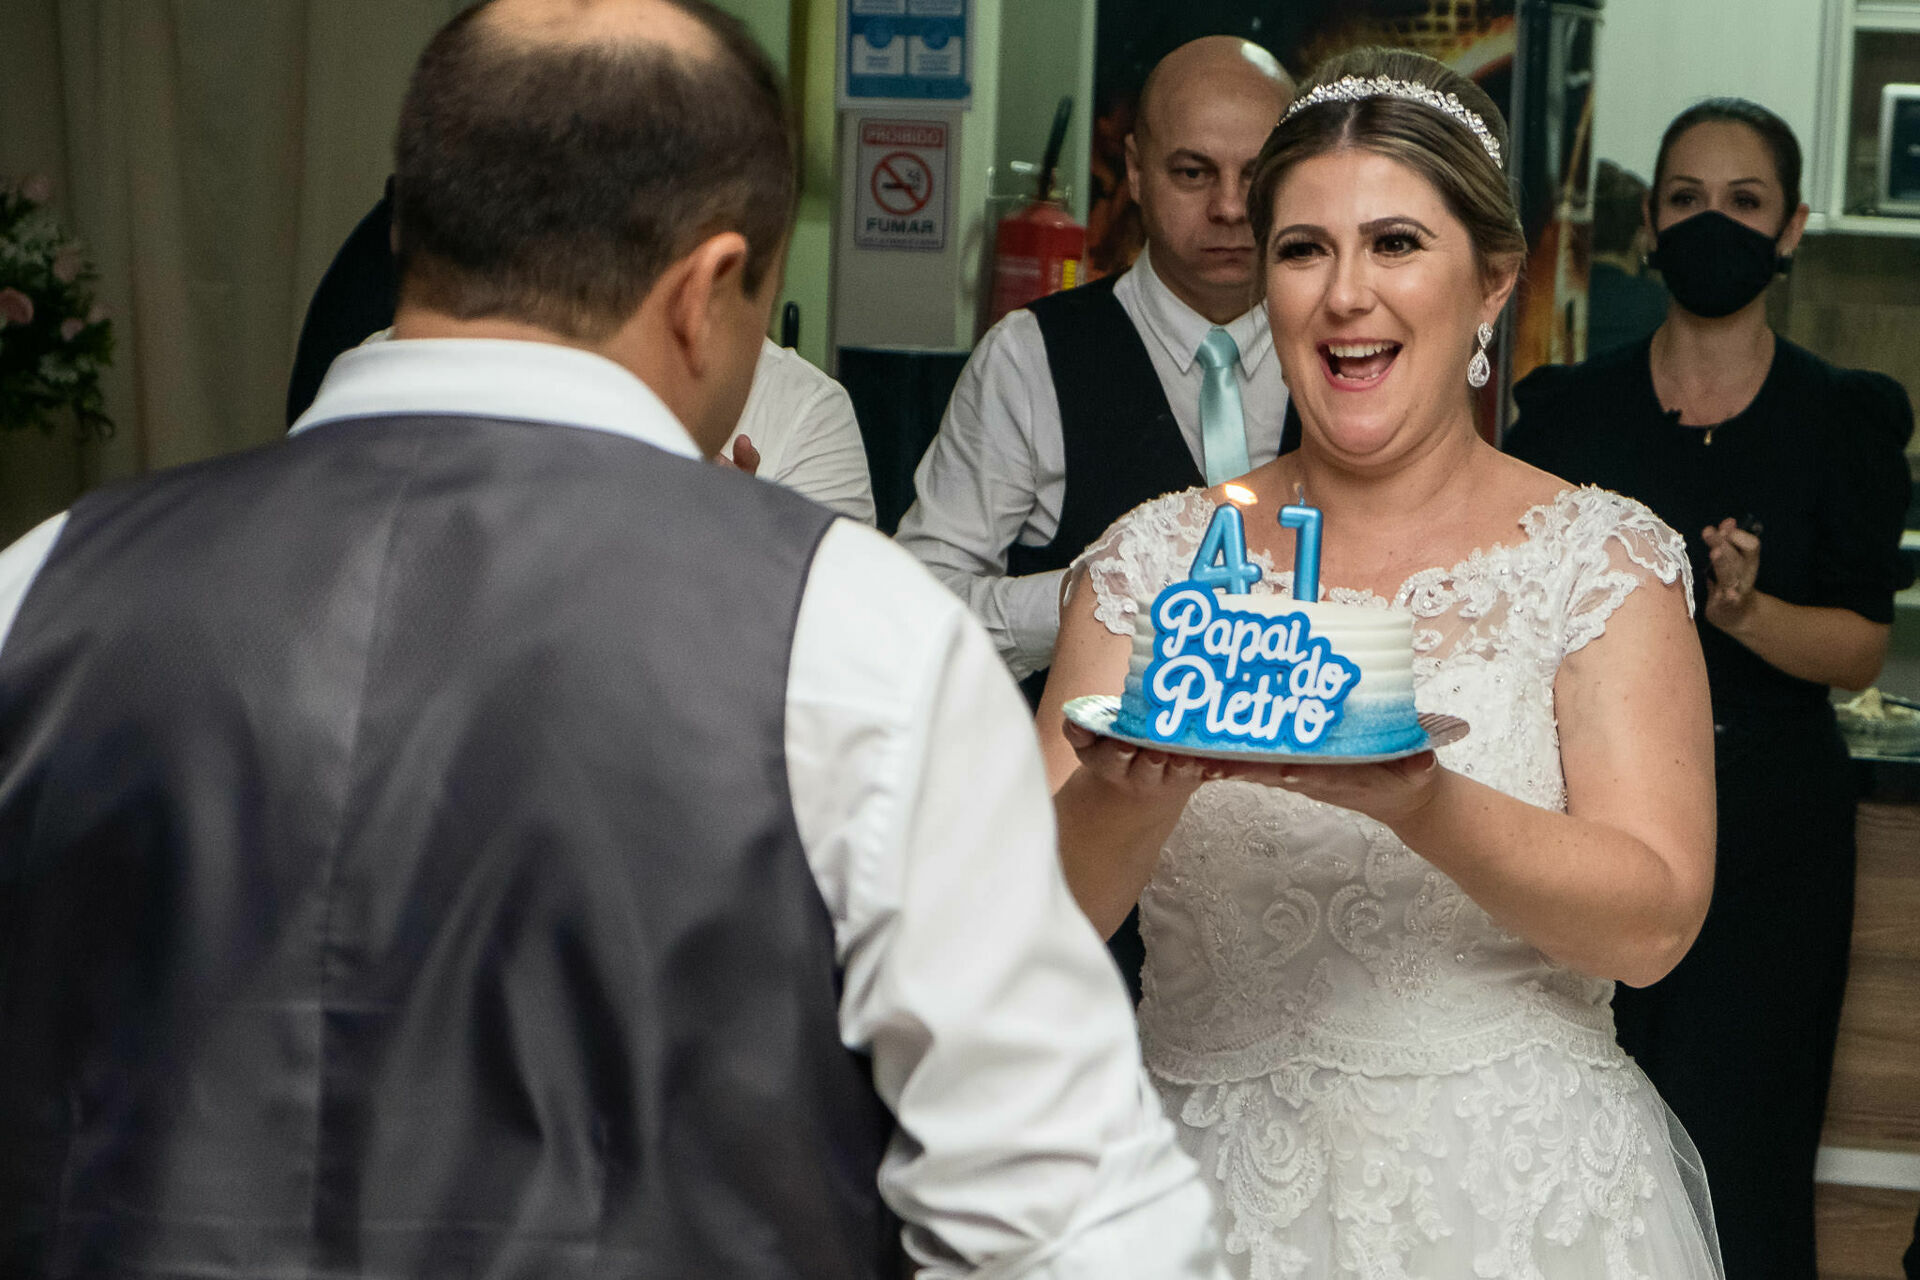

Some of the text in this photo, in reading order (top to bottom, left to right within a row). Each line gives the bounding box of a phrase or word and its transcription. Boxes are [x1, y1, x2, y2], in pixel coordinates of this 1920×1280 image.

[866, 217, 934, 234] FUMAR
[1159, 589, 1351, 699] Papai do
[1153, 654, 1335, 743] Pietro
